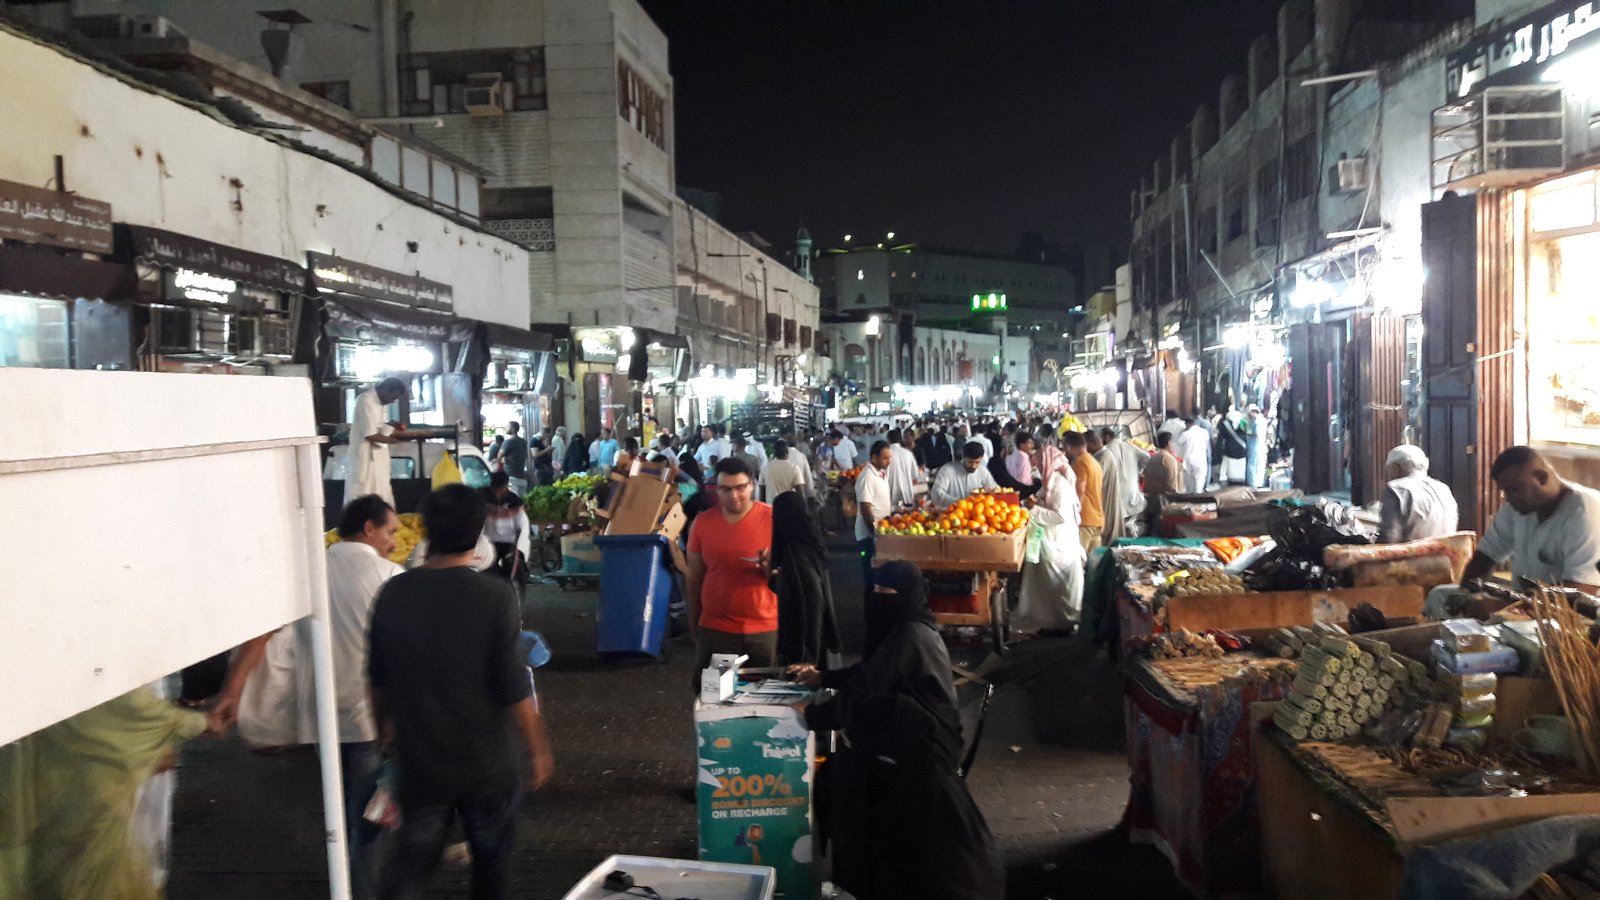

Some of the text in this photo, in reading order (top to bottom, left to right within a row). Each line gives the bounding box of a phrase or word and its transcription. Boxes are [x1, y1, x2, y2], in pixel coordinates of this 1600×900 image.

[710, 766, 741, 775] UP TO
[711, 773, 792, 798] 200%
[711, 807, 790, 820] ON RECHARGE
